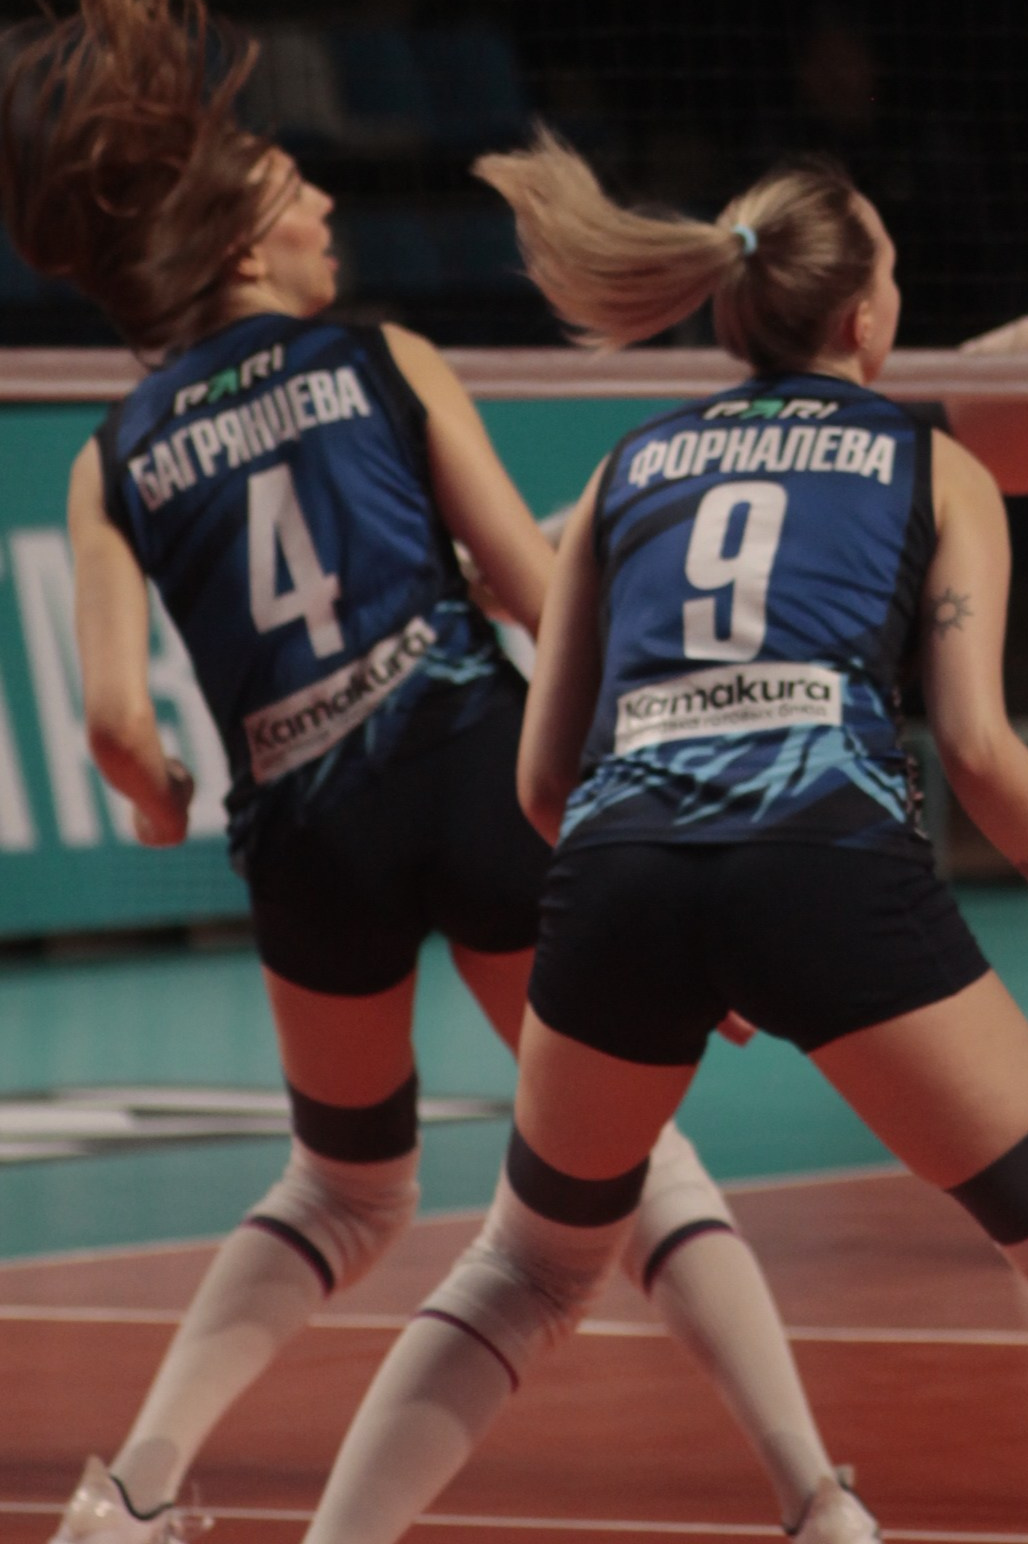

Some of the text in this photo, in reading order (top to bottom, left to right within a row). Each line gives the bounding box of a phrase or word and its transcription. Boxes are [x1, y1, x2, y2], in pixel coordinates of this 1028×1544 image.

[126, 363, 373, 513] БАГРЯНЦЕВА
[627, 424, 897, 490] ФОРНАЛЕВА
[246, 460, 346, 660] 4
[681, 480, 789, 663] 9
[252, 631, 430, 753] Kamakura
[625, 674, 831, 719] Kamakura
